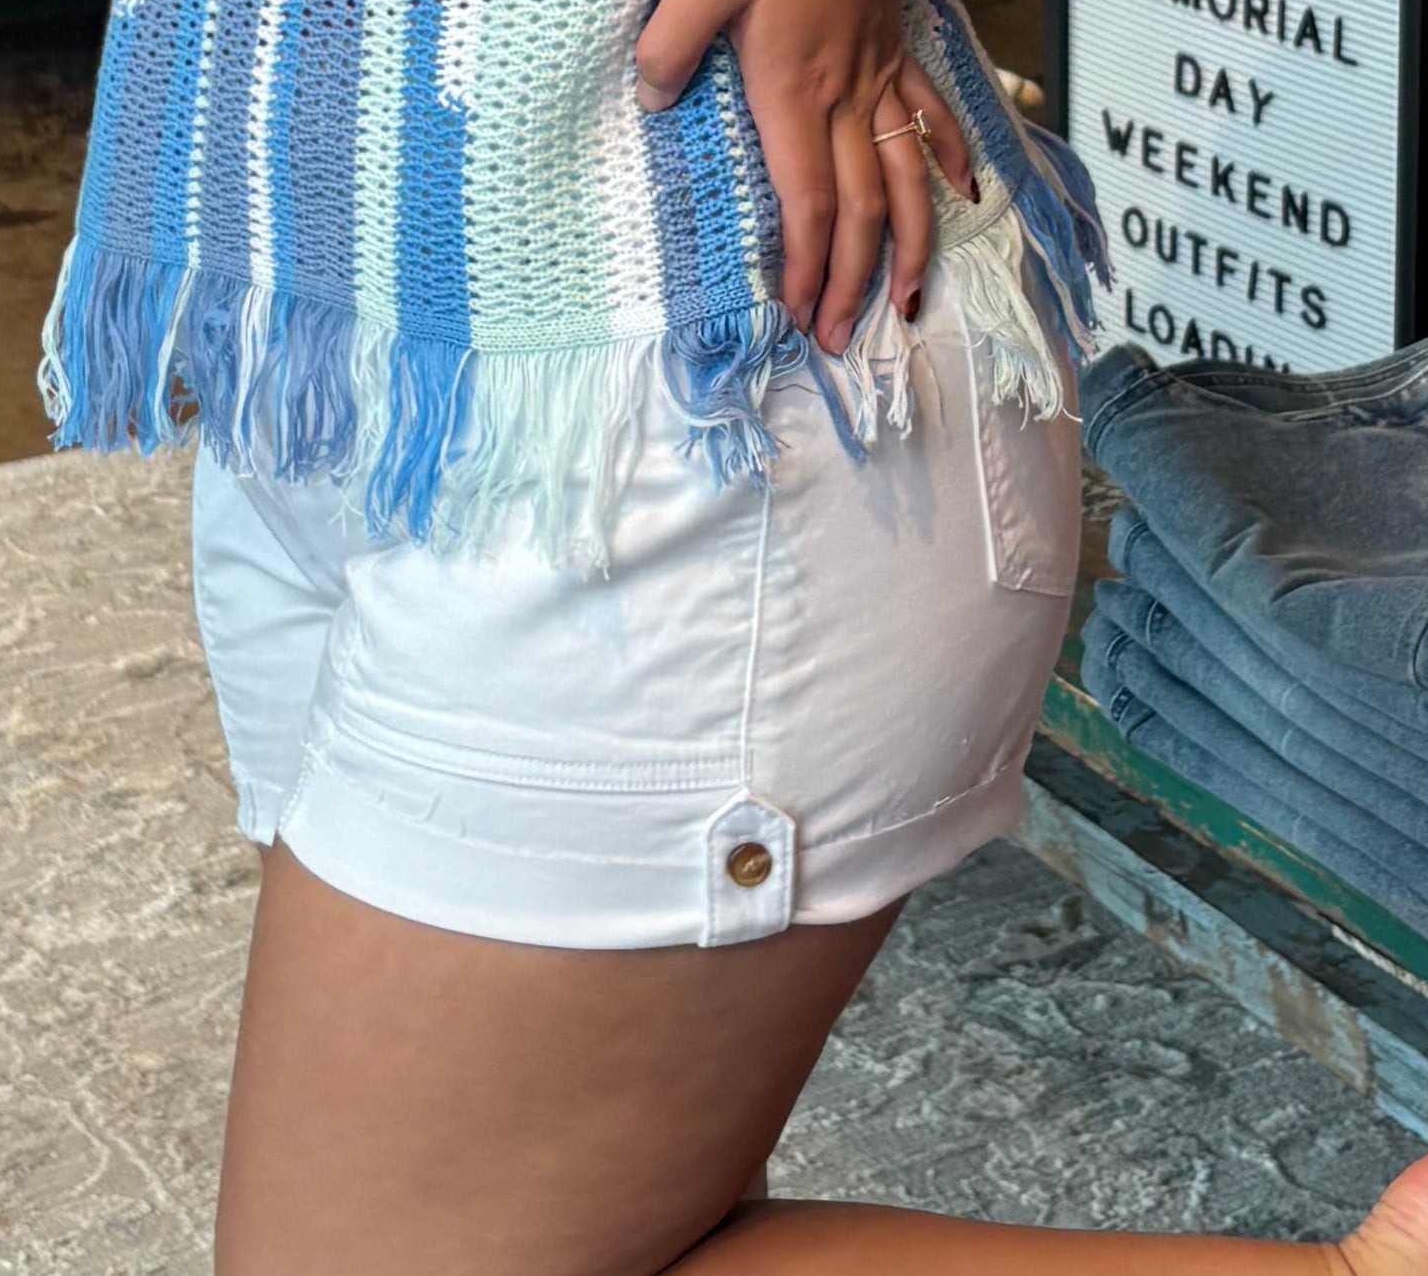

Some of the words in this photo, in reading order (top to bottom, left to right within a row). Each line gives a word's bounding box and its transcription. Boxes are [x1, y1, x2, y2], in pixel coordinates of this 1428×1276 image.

[1174, 51, 1275, 125] DAY
[1101, 106, 1353, 248] WEEKEND
[1121, 205, 1330, 331] OUTFITS
